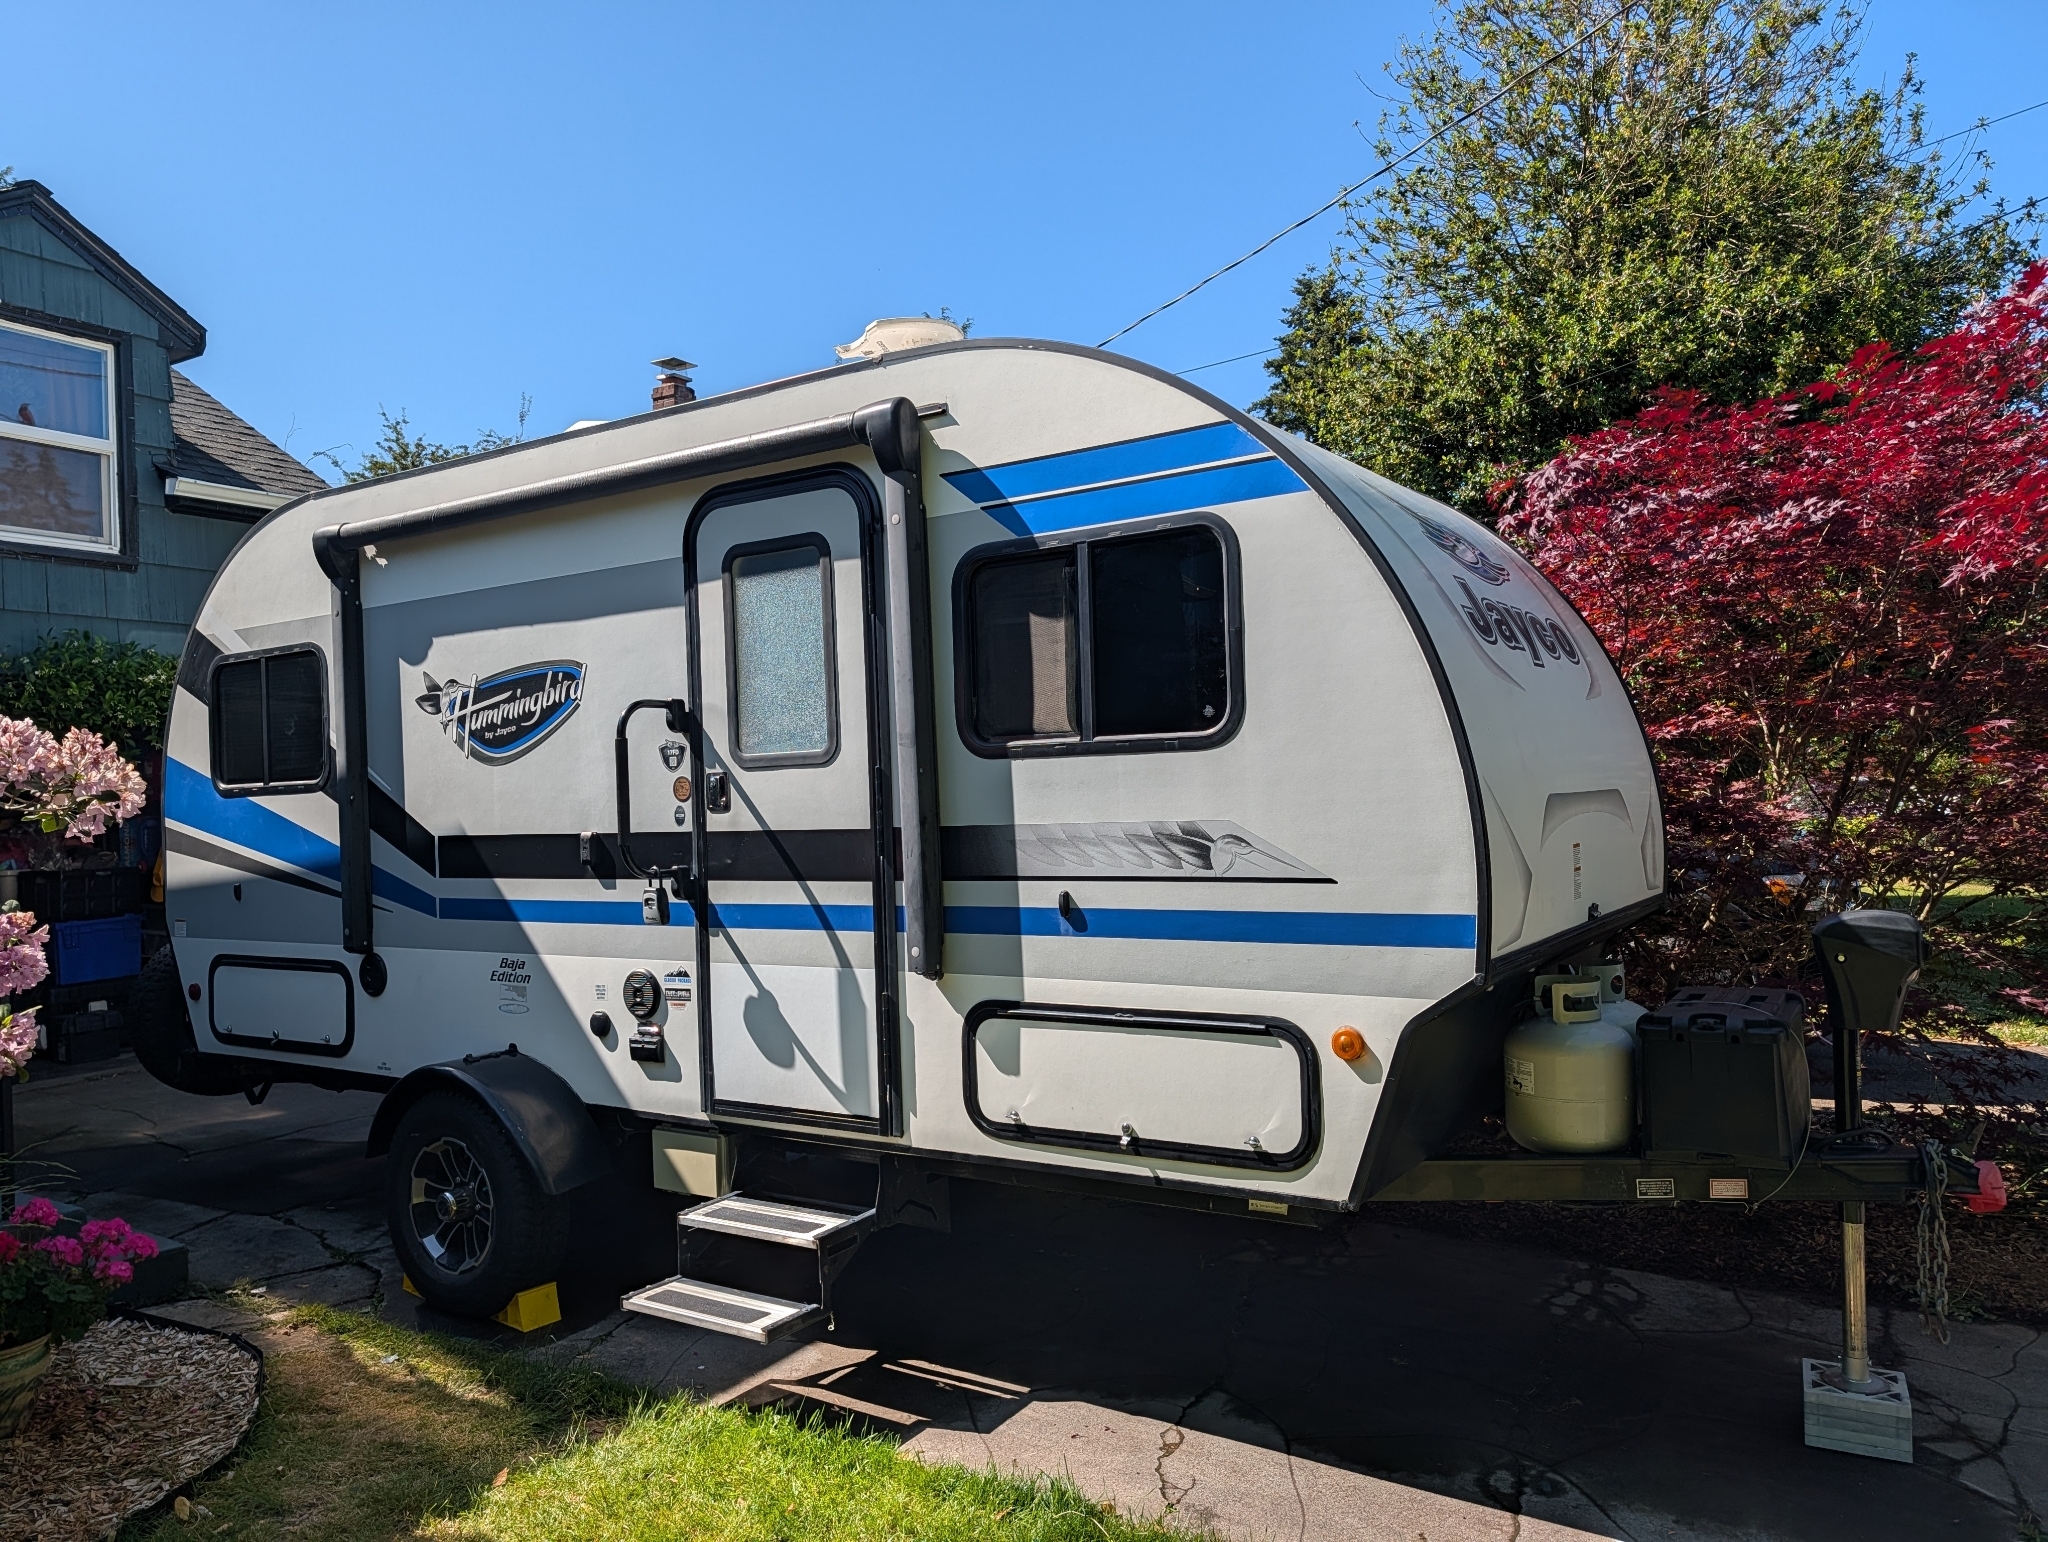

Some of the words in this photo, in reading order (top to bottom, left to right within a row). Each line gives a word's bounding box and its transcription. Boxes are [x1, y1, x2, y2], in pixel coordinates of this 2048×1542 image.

[1452, 575, 1580, 668] Jayco
[439, 663, 588, 759] Hummingbird
[485, 731, 494, 739] by
[495, 725, 516, 736] Jayco
[499, 957, 526, 971] Baja
[490, 970, 531, 985] Edition
